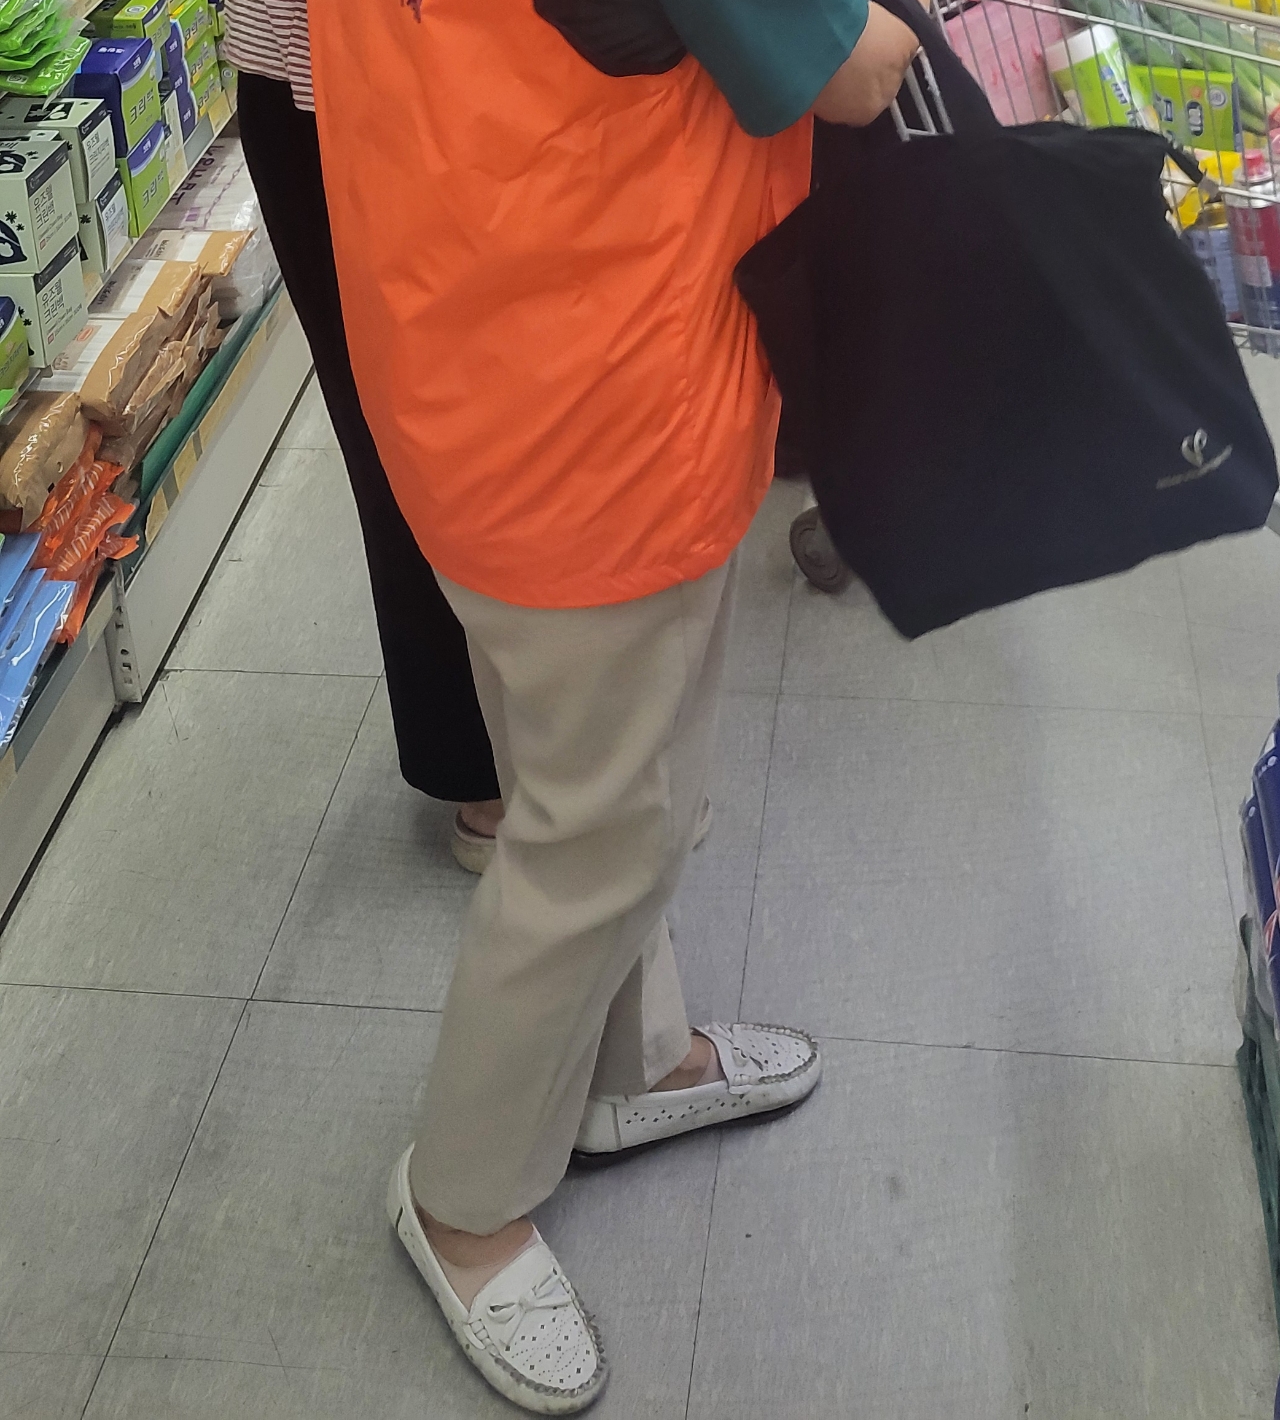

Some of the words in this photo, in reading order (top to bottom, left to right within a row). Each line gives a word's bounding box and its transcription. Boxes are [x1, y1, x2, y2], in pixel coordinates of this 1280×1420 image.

[129, 88, 154, 126] 크린백
[34, 183, 54, 214] 유즈웰
[142, 168, 164, 209] 크린백
[36, 200, 56, 230] 크린백
[42, 278, 63, 309] 유즈웰
[44, 294, 65, 325] 크린백
